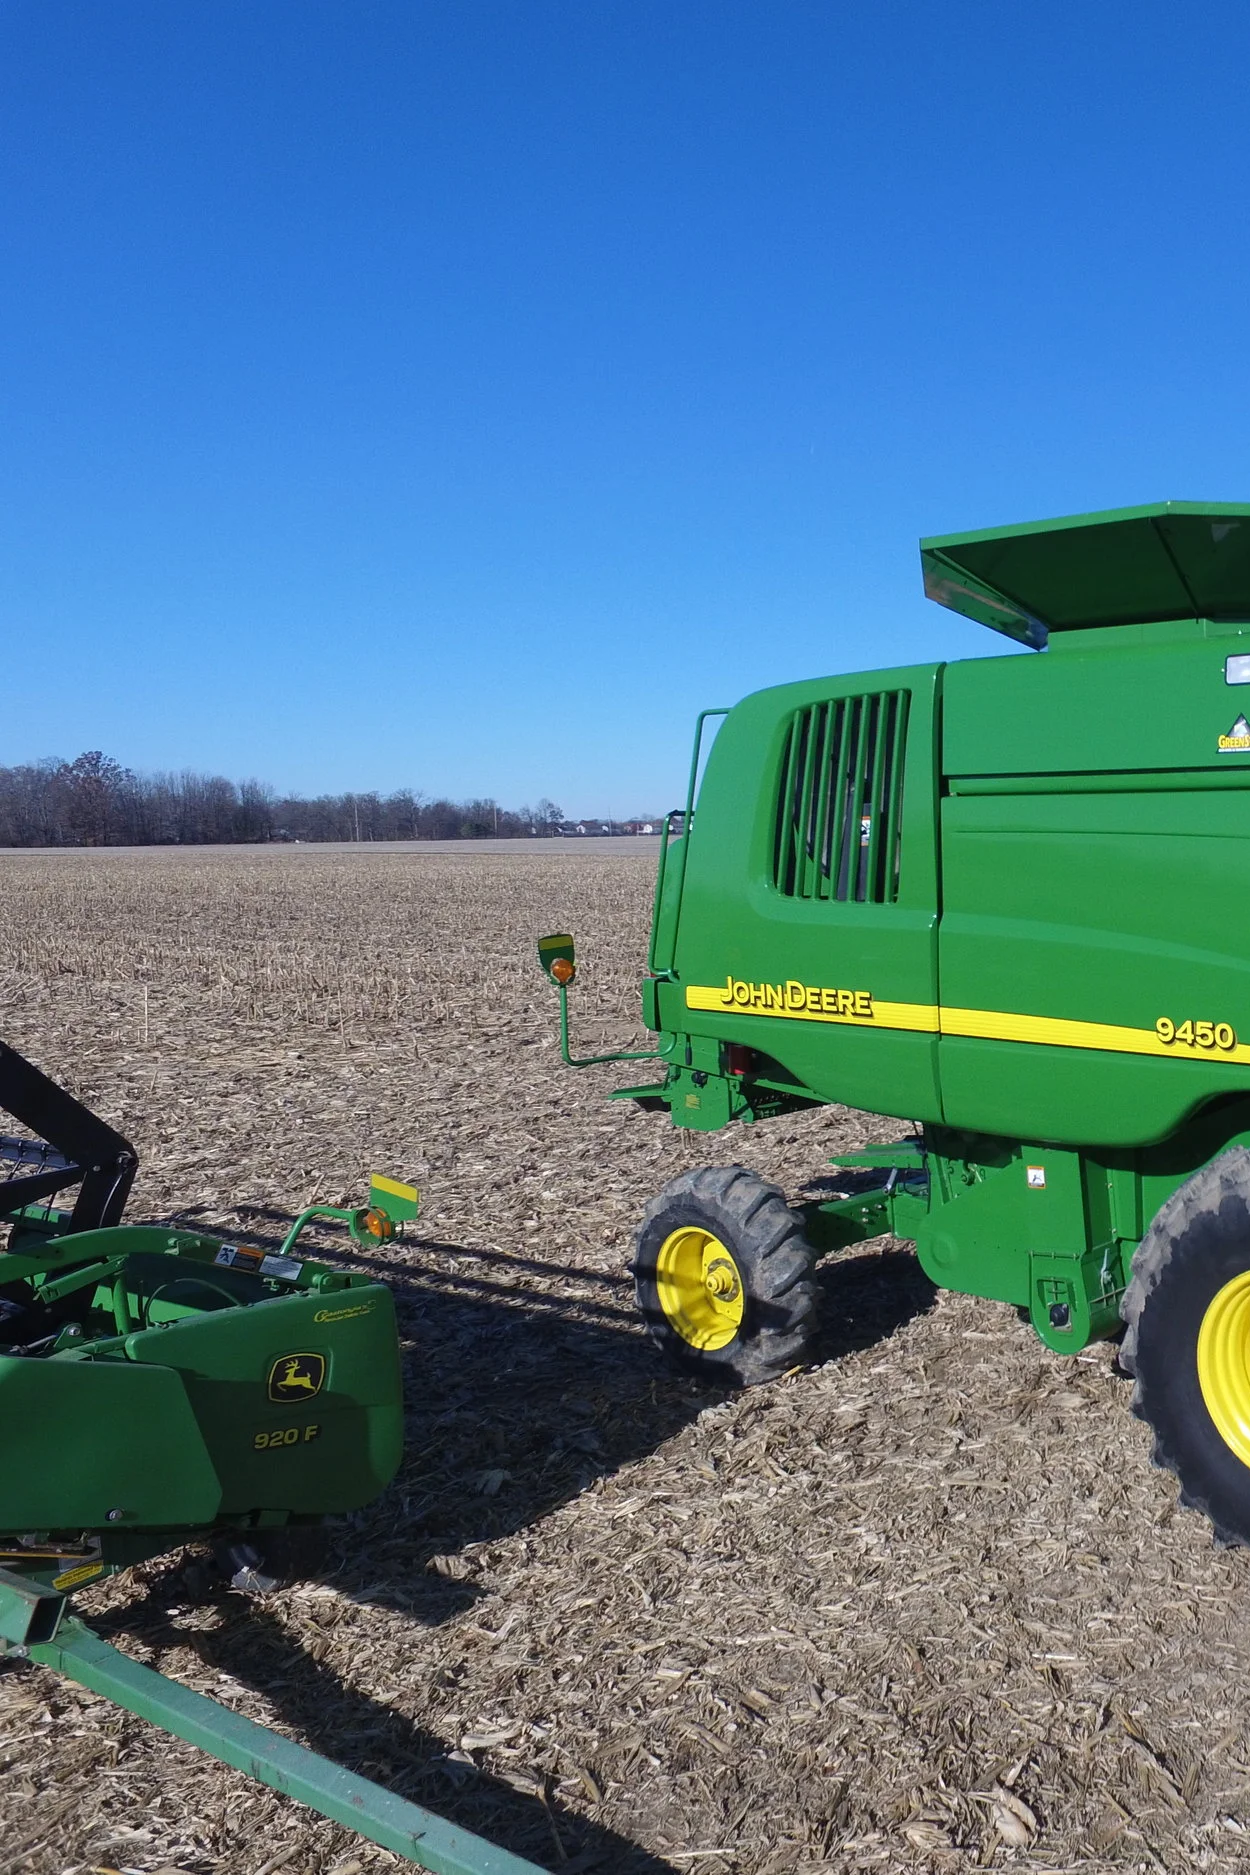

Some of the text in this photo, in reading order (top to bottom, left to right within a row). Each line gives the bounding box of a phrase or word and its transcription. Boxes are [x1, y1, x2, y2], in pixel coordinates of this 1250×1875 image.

[720, 976, 873, 1016] JOHN DEERE
[1155, 1016, 1236, 1050] 9450
[254, 1424, 318, 1449] 920 F
